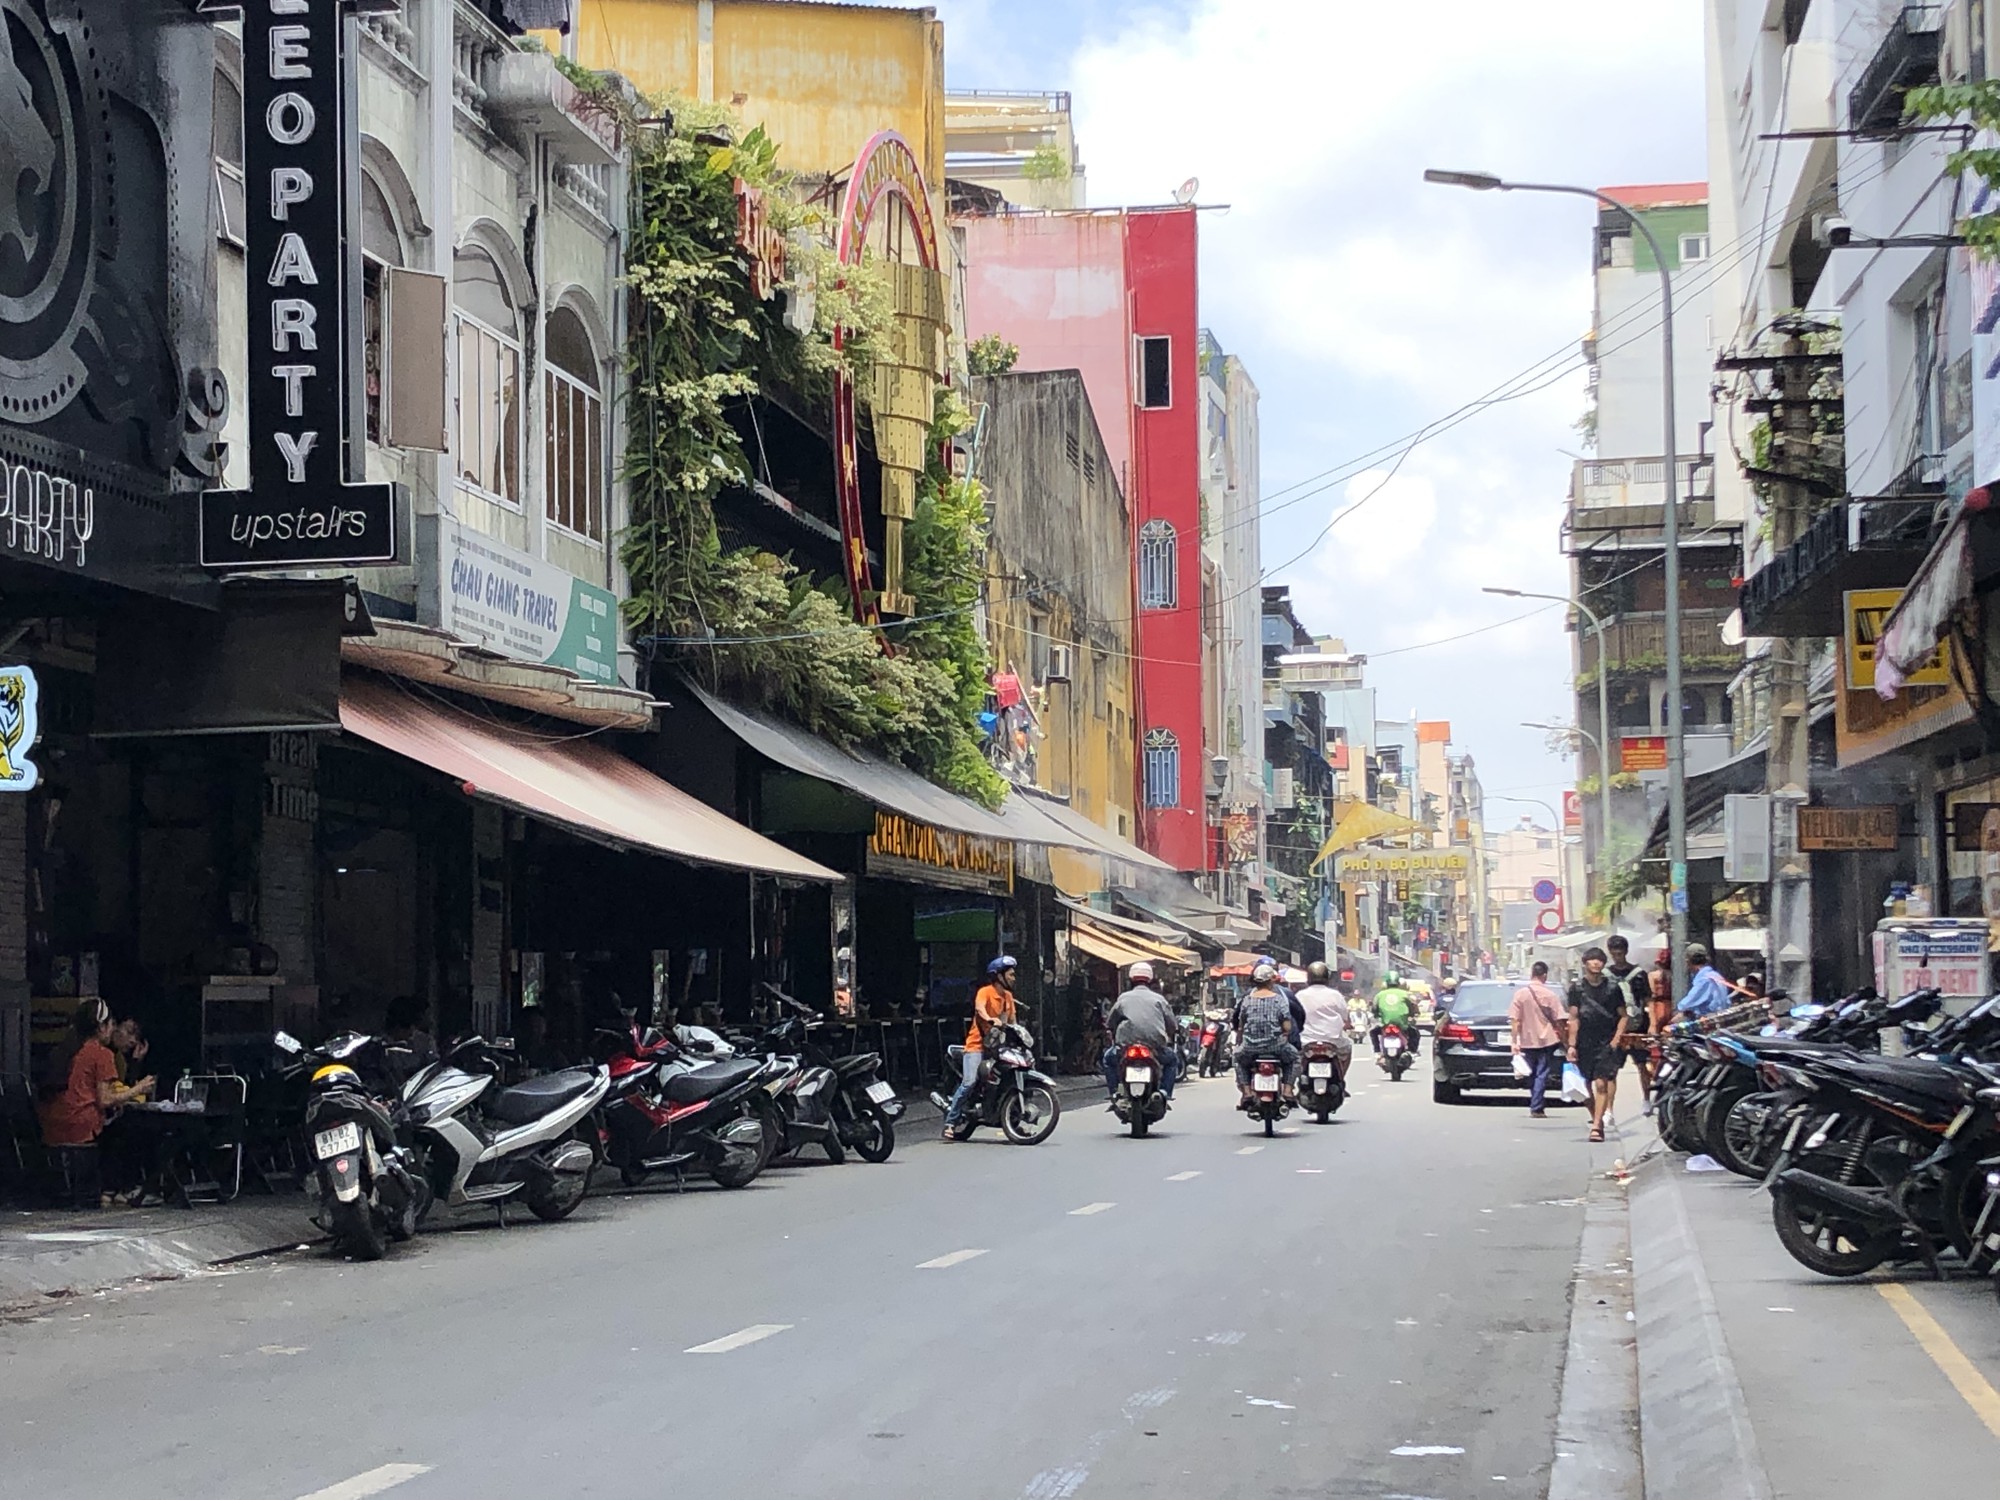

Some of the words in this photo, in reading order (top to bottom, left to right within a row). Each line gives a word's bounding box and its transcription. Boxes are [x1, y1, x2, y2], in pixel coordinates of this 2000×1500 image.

[230, 505, 367, 548] upstairs
[451, 559, 483, 602] CHAU
[486, 572, 520, 617] GIANG
[523, 588, 558, 632] TRAVEL
[269, 731, 321, 769] Break
[270, 776, 320, 823] Time
[1903, 968, 1932, 994] FOR
[1938, 968, 1978, 993] RENT
